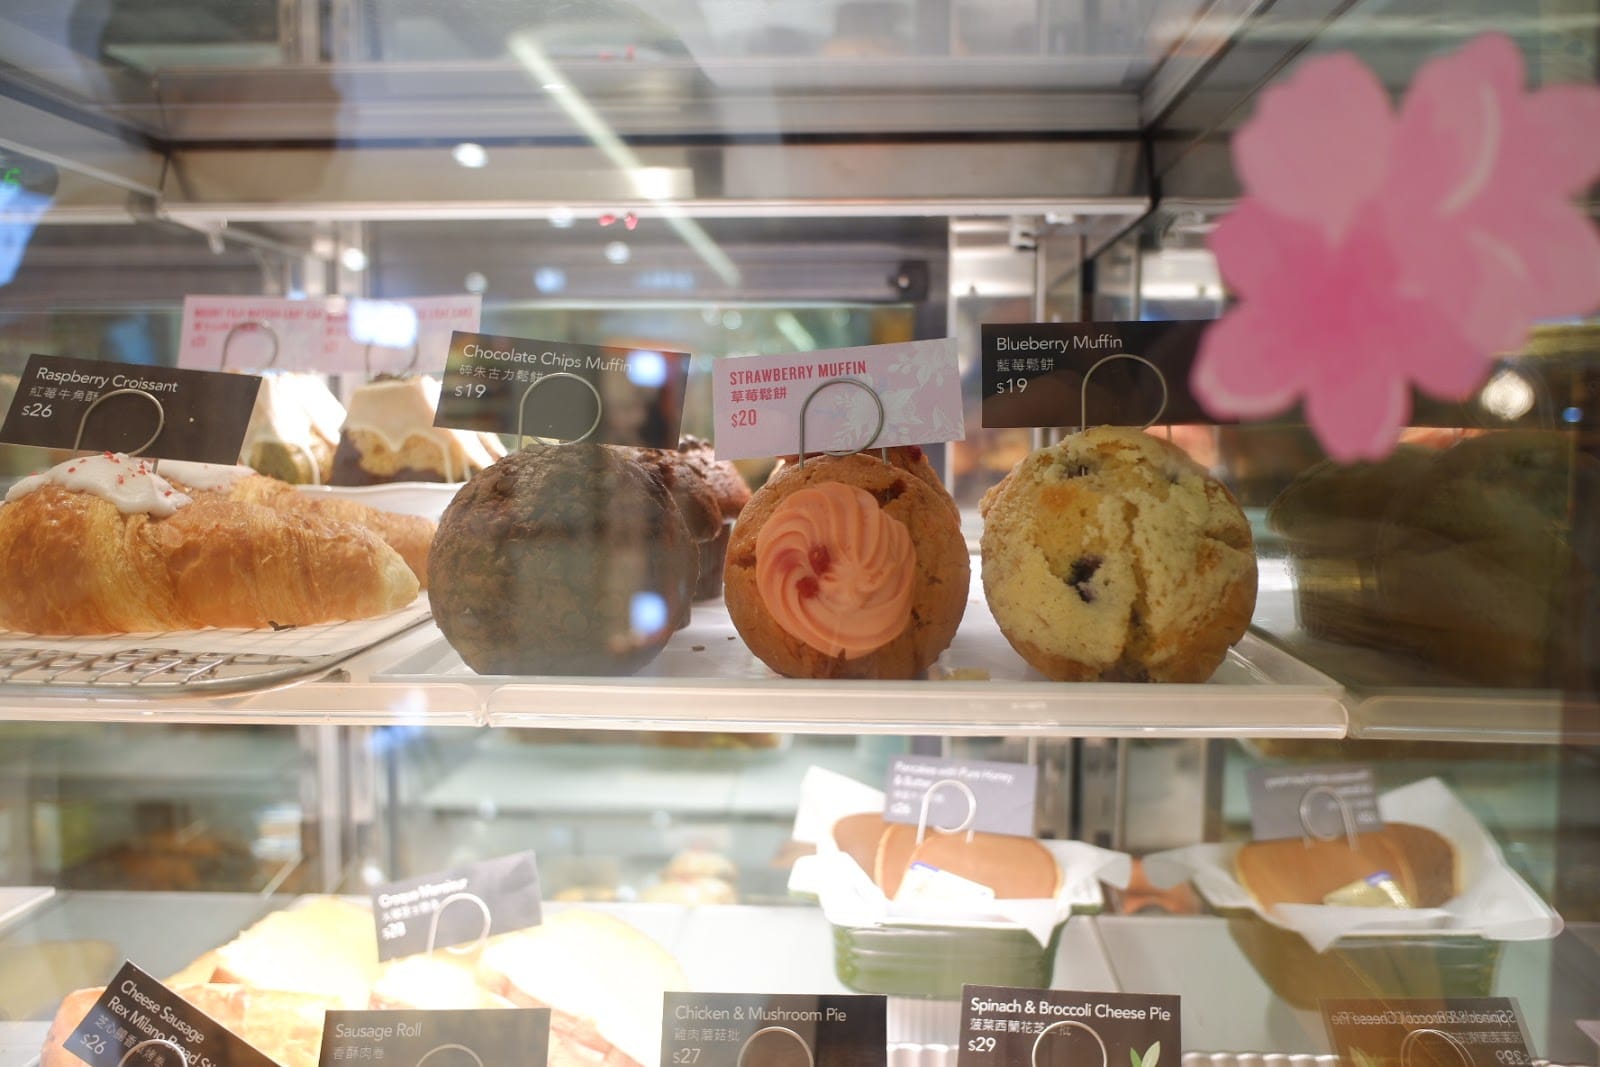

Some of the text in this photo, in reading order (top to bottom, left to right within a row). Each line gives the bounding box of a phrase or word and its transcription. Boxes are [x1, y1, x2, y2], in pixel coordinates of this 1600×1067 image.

[997, 334, 1122, 354] Blueberry Muffin
[463, 344, 632, 373] Chocolate Chips Muffin
[997, 358, 1055, 372] 藍莓鬆餅
[36, 367, 179, 393] Raspberry Croissant
[730, 360, 867, 386] STRAWBERRY MUFFIN
[731, 387, 788, 403] 草莓鬆餅
[731, 408, 757, 428] $20
[107, 996, 131, 1019] Rex
[129, 1009, 165, 1040] Milano
[121, 980, 205, 1044] Cheese Sausage
[675, 1005, 847, 1022] Chicken & Mushroom Pie
[970, 997, 1171, 1021] Spinach & Broccoli Cheese Pie
[335, 1022, 423, 1042] Sausage Roll
